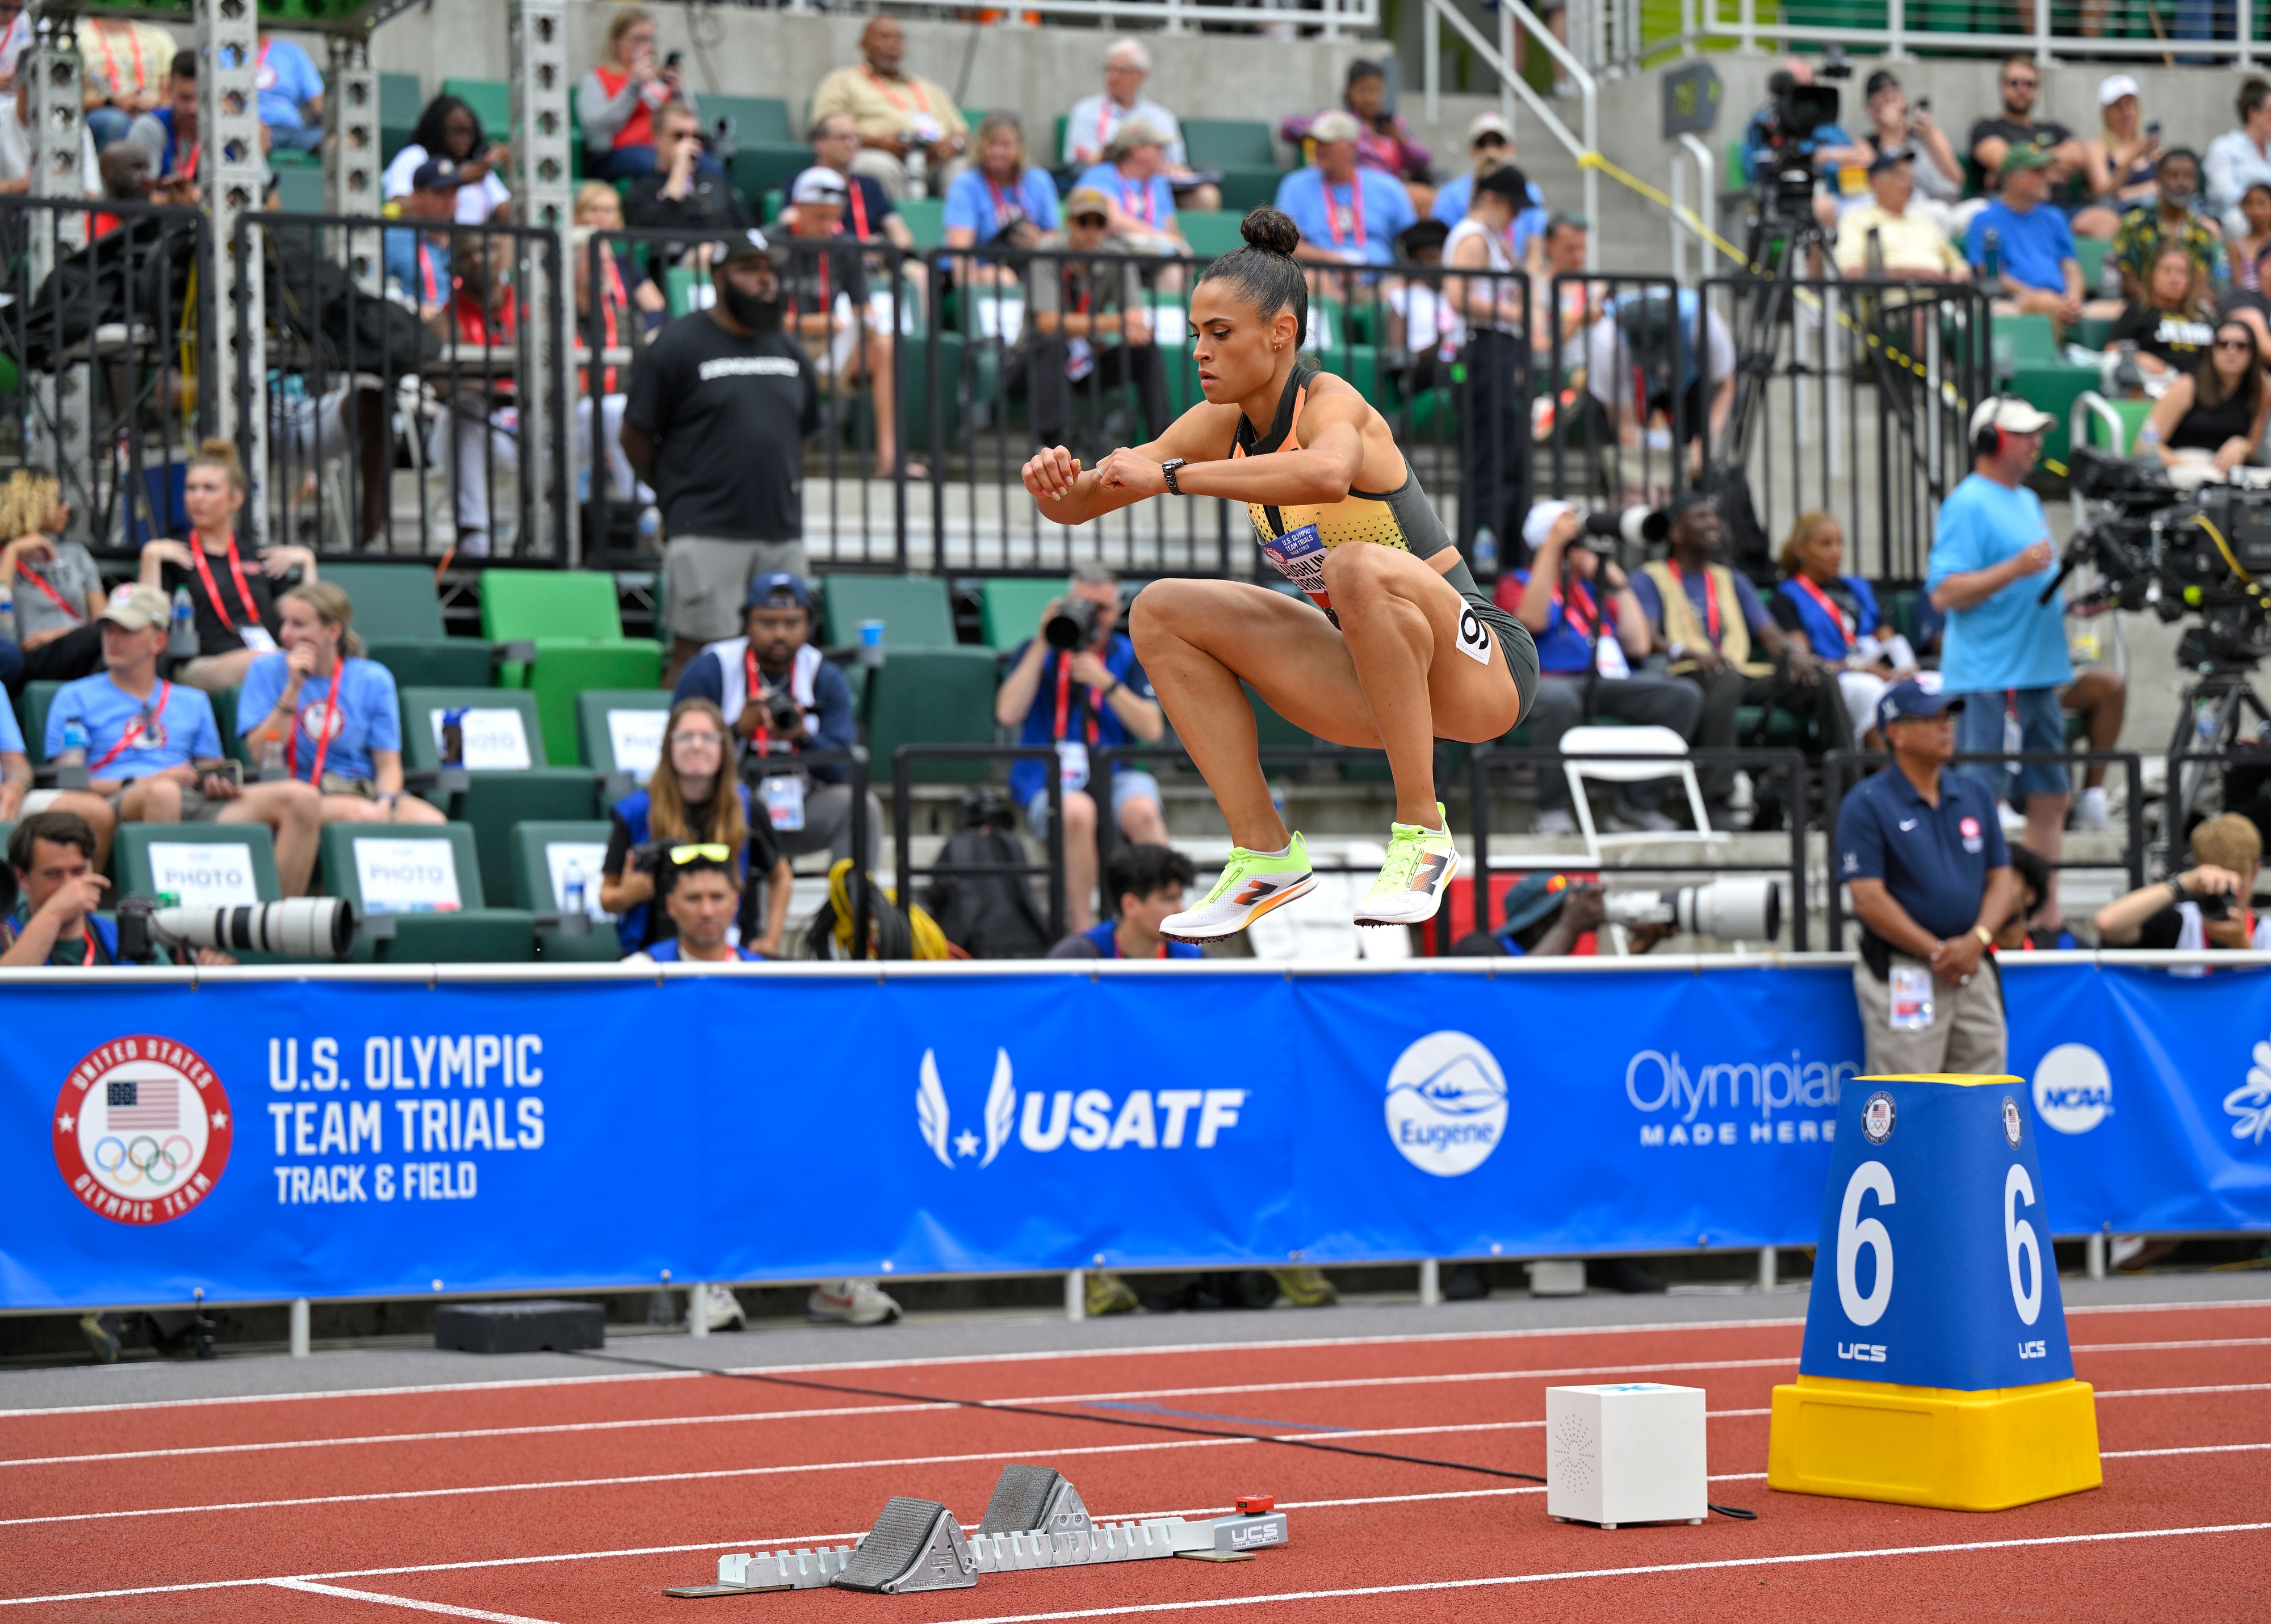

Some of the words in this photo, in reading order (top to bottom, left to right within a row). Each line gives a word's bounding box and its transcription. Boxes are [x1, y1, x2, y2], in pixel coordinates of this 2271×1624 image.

[1282, 538, 1292, 546] U.S.
[1292, 528, 1310, 542] OLYMPIC
[1285, 542, 1298, 552] TEAM
[1297, 534, 1313, 546] TRIALS
[165, 867, 243, 889] PHOTO
[370, 864, 444, 886] PHOTO
[71, 1039, 138, 1091] UNITED
[146, 1039, 213, 1089] STATES
[269, 1037, 351, 1092] U.S.
[364, 1034, 543, 1090] OLYMPIC
[2044, 1086, 2107, 1111] NCAA
[267, 1100, 383, 1156] TEAM
[395, 1097, 545, 1153] TRIALS
[1019, 1088, 1246, 1153] USATF
[1640, 1122, 1738, 1148] MADE
[1750, 1119, 1836, 1145] HERE
[1401, 1119, 1495, 1153] Eugene
[74, 1173, 153, 1222] OLYMPIC
[162, 1172, 212, 1217] TEAM
[274, 1164, 368, 1205] TRACK
[374, 1163, 396, 1202] &
[403, 1161, 477, 1201] FIELD
[1837, 1160, 1896, 1327] 6
[2005, 1163, 2042, 1326] 6
[1838, 1341, 1887, 1362] UCS
[2018, 1340, 2046, 1359] UCS
[1231, 1523, 1278, 1542] UCS
[931, 1555, 952, 1566] UCS
